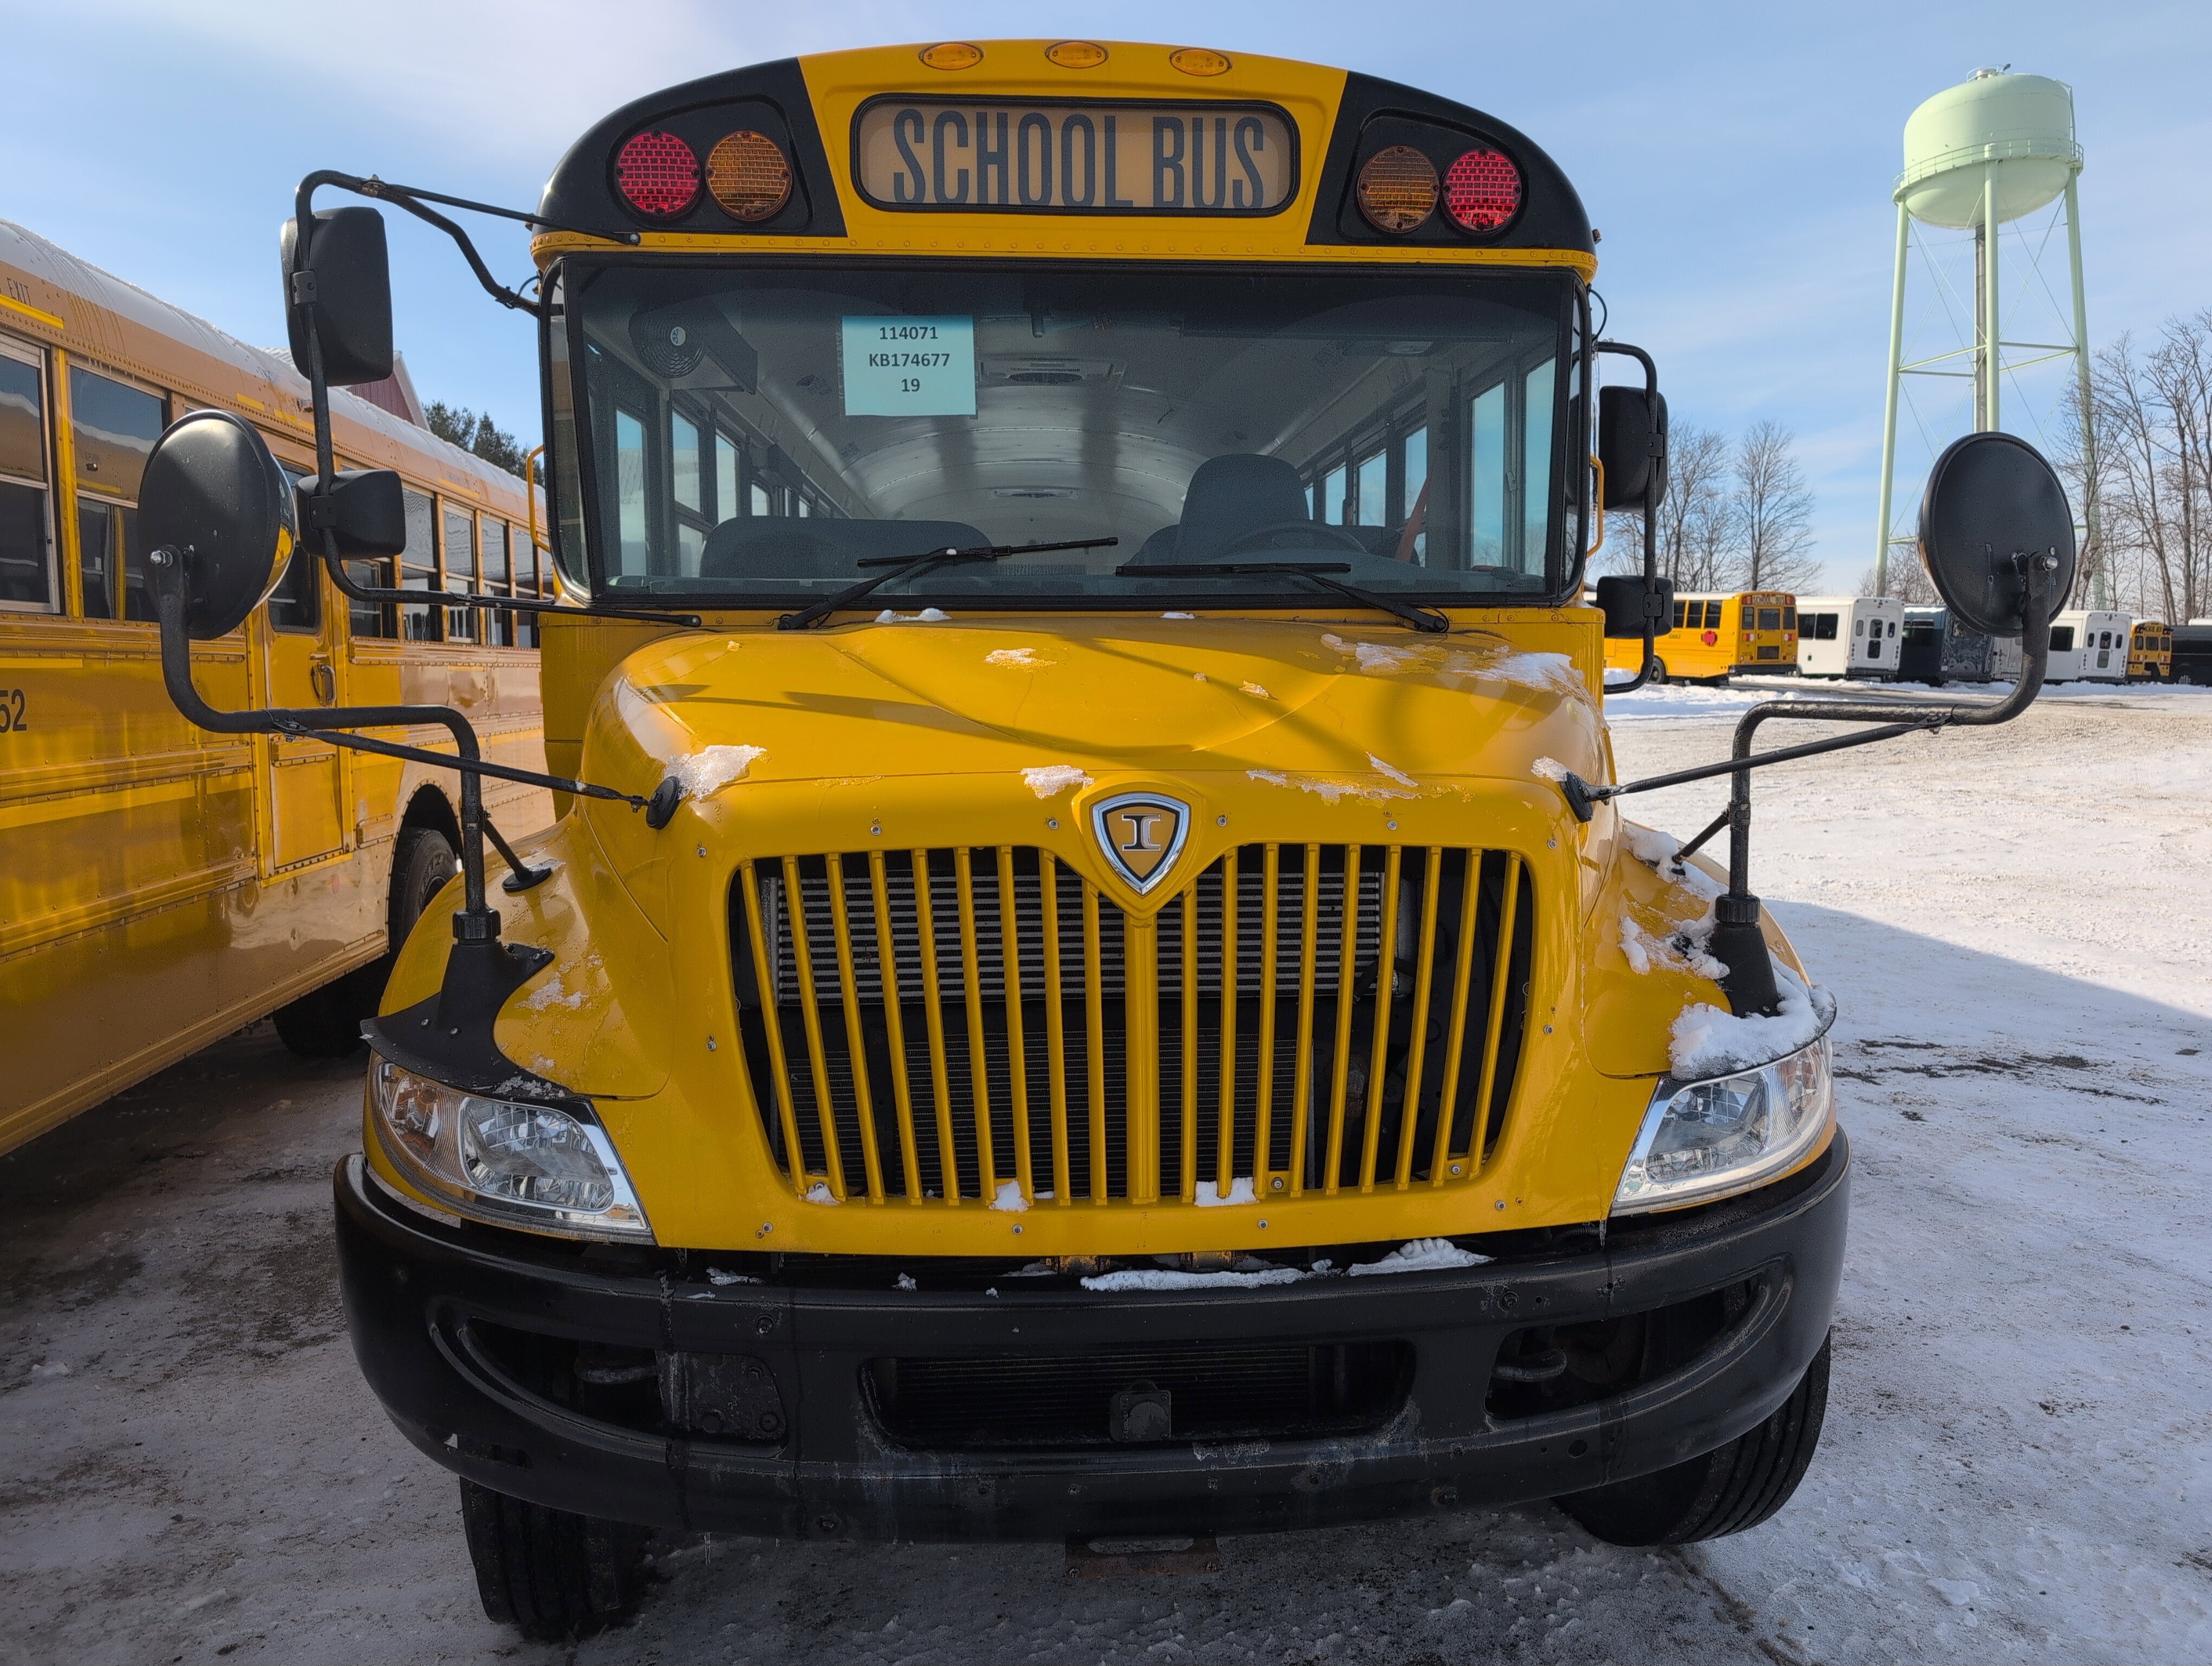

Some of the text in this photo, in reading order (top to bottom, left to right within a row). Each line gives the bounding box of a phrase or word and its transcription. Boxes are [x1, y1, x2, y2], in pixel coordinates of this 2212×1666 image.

[893, 108, 1264, 209] SCHOOL BUS
[6, 277, 31, 306] EXIT
[879, 326, 938, 340] 114071
[869, 353, 950, 367] KB174677
[901, 379, 921, 392] 19
[1752, 595, 1785, 605] SCHOOL BUS
